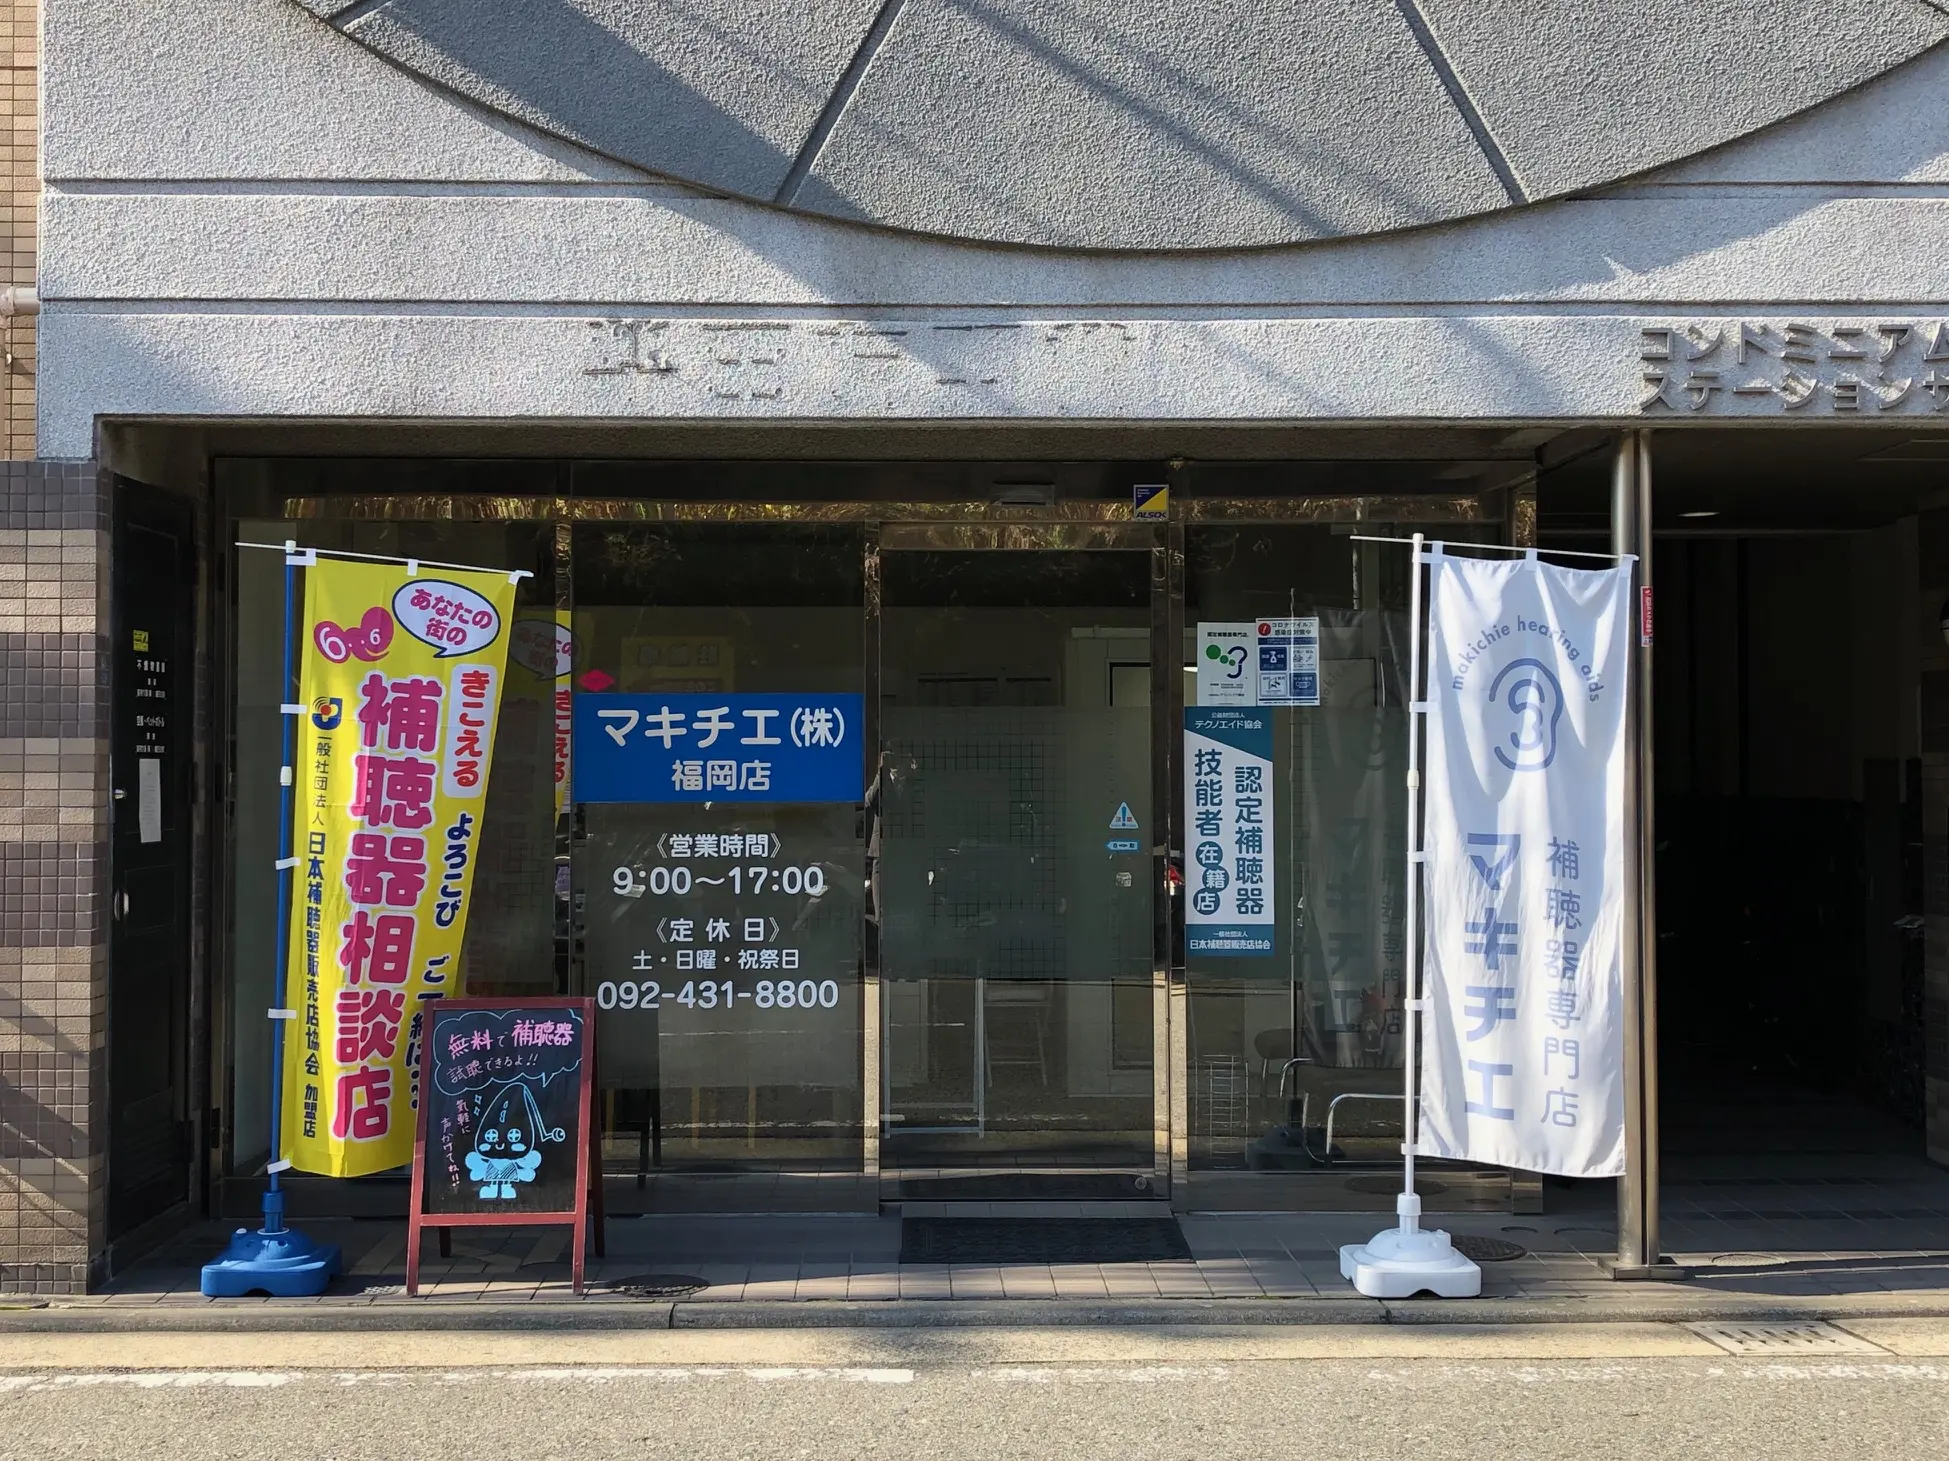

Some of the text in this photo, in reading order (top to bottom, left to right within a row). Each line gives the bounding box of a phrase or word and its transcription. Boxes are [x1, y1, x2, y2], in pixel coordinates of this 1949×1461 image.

[1136, 511, 1167, 519] ALSOK
[409, 586, 494, 631] あなたの
[424, 617, 468, 647] 街の
[1452, 614, 1606, 702] makichie hearing aids
[452, 669, 491, 788] きこえる
[596, 705, 846, 750] マキチエ(株)
[1194, 719, 1263, 730] テクノエイド協会
[312, 735, 333, 826] 一般社団法人
[671, 759, 772, 792] 福岡店
[1193, 748, 1223, 838] 技能者
[655, 831, 783, 859] 《営業時間》
[1234, 765, 1264, 915] 認定補聴器
[434, 812, 475, 928] よろこび
[612, 865, 825, 896] 9:00〜17:00
[332, 673, 443, 1140] 補聴器相談店
[631, 949, 800, 972] 土・日曜・祝祭日
[1462, 831, 1522, 1121] マキチエ
[1539, 835, 1583, 1128] 補聴器専門店
[596, 980, 839, 1010] 092-431-8800
[302, 1083, 319, 1139] 加盟店
[454, 1098, 472, 1134] 気軽に
